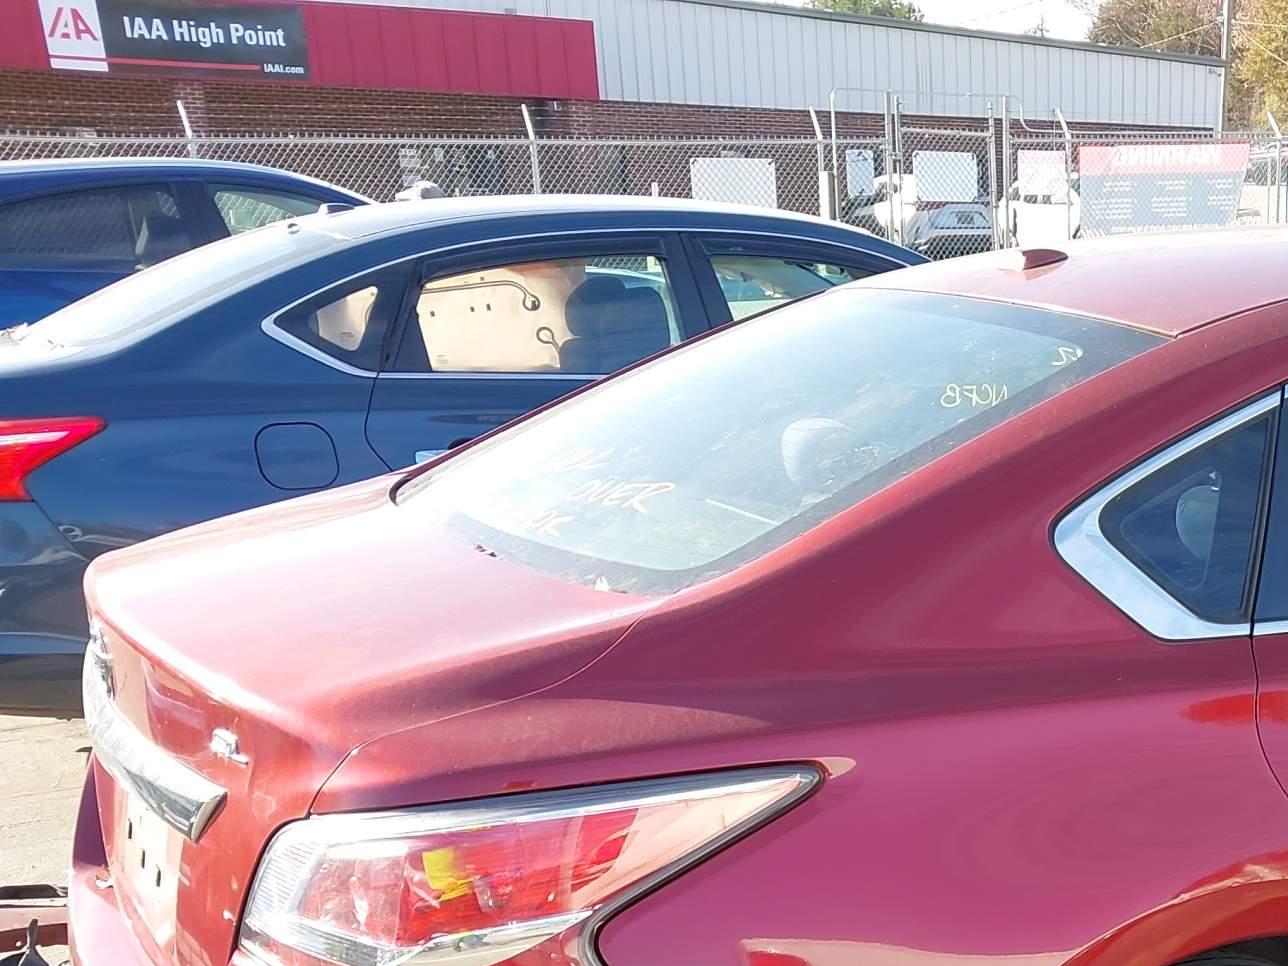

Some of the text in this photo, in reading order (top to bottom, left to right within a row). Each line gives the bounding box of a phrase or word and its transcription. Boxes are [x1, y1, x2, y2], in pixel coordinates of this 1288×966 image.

[123, 16, 286, 48] IAA High Point
[263, 62, 305, 75] IAAI.com
